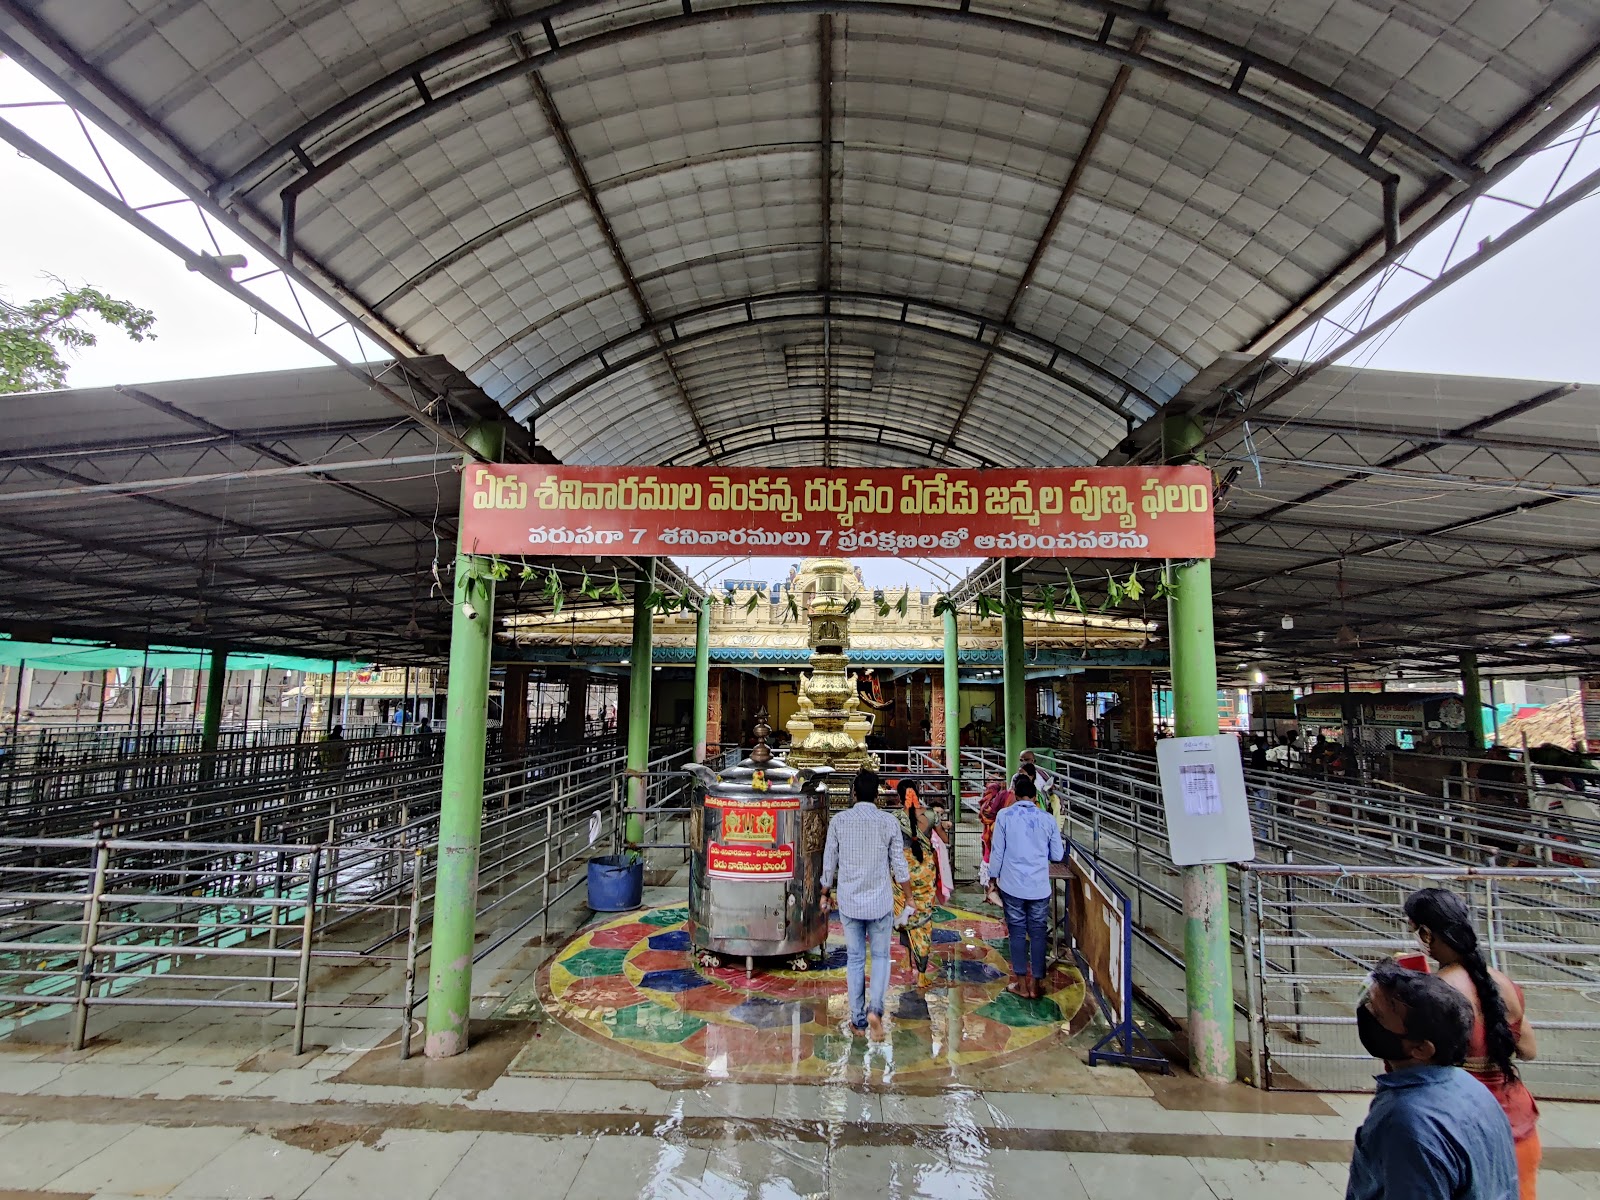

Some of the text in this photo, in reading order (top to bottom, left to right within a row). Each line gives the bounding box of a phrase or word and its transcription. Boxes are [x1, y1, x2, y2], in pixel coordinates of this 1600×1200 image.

[473, 469, 1207, 529] ఏడు శనివారముల వెంకన్న దర్శనం ఏడేడు జన్మల పుణ్య ఫలం
[528, 525, 1149, 555] వరుసగా 7 శనివారములు 7 ప్రదక్షణలతో ఆచరించవలెను
